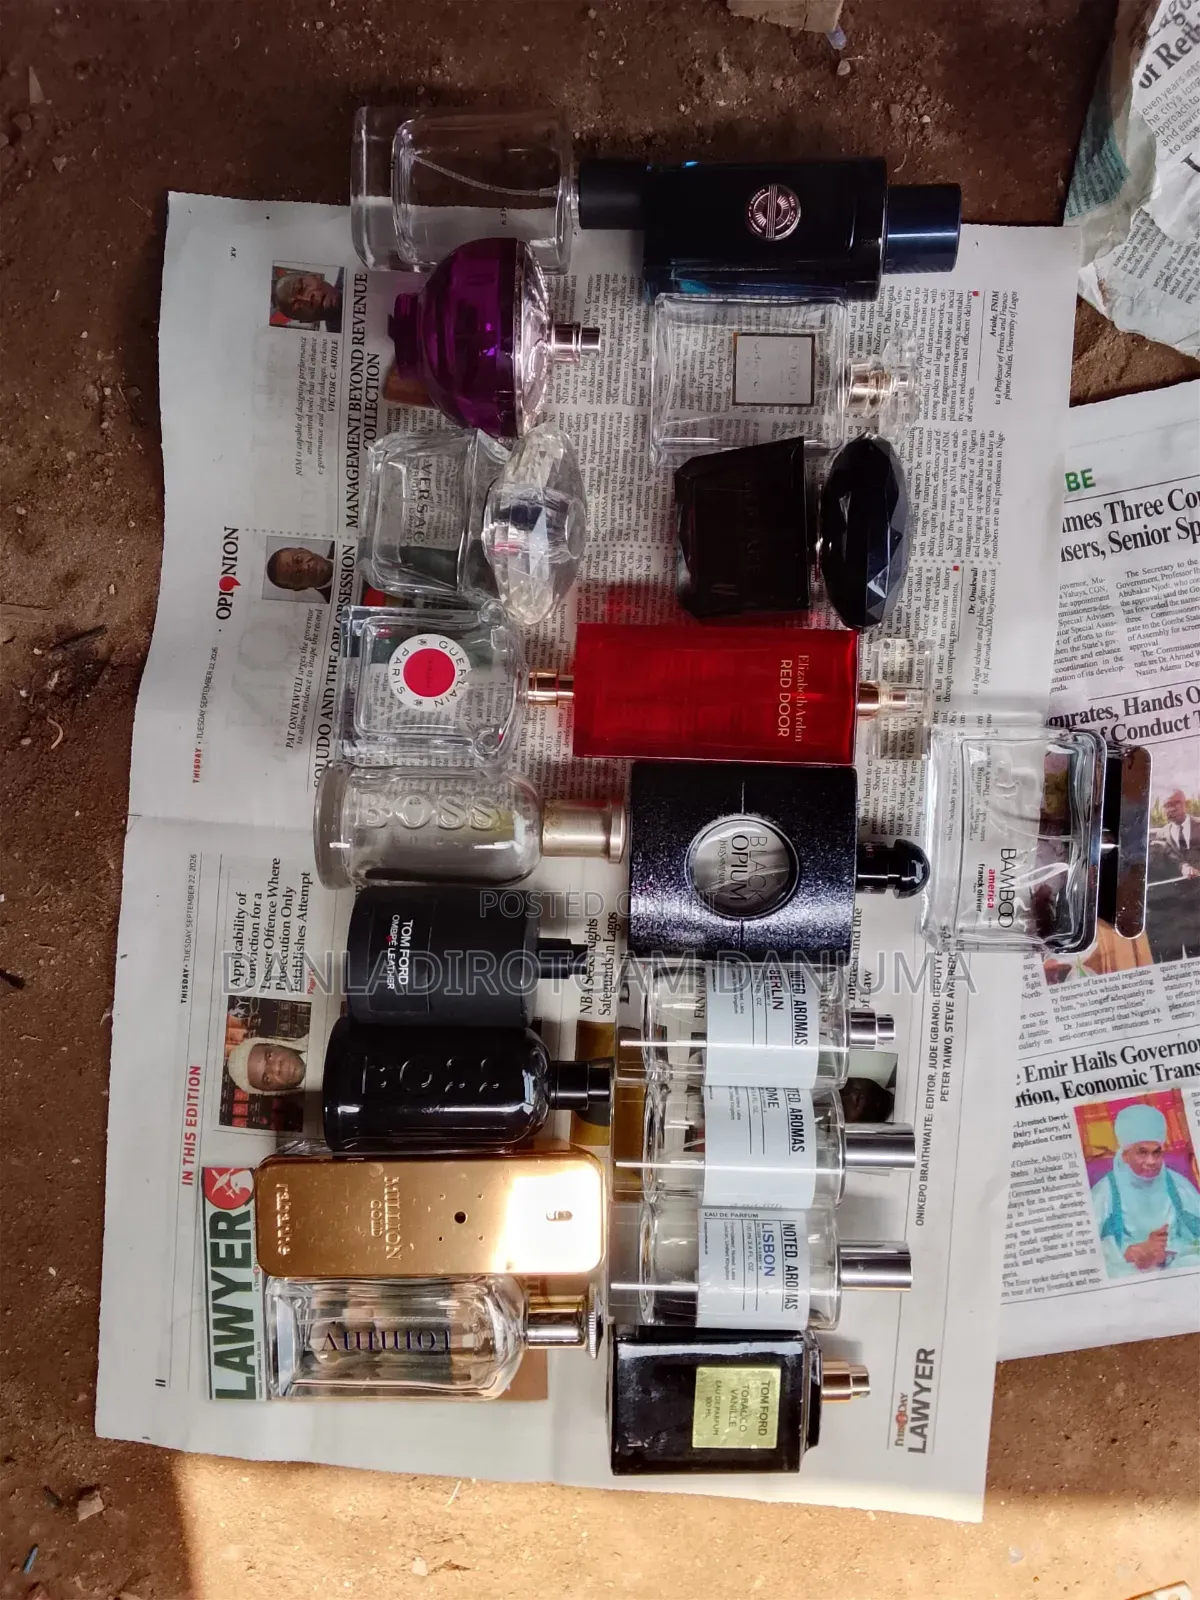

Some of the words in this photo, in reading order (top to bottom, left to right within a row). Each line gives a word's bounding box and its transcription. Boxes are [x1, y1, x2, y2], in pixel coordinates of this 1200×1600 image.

[1153, 102, 1192, 138] approach
[1160, 129, 1179, 147] and
[1168, 143, 1181, 155] to
[352, 273, 368, 346] REVENUE
[965, 290, 973, 317] delivery
[991, 290, 999, 312] FNIM
[1009, 291, 1019, 310] Lagos
[962, 319, 971, 345] efficient
[989, 314, 998, 337] Ariole,
[994, 364, 1004, 392] Professor
[1000, 292, 1008, 316] Franco-
[1007, 319, 1017, 352] University
[298, 336, 308, 380] performance
[309, 337, 318, 366] enhance
[320, 338, 328, 364] reckons
[330, 340, 339, 370] ARIOLE
[1004, 354, 1014, 378] Studies,
[329, 372, 337, 380] C.
[348, 349, 364, 412] BEYOND
[1003, 380, 1012, 400] phone
[296, 381, 307, 412] designing
[327, 382, 337, 412] VICTOR
[364, 352, 380, 450] COLLECTION
[296, 423, 305, 449] capable
[306, 415, 314, 439] control
[346, 414, 362, 528] MANAGEMENT
[414, 463, 433, 543] VERSAC
[1104, 499, 1164, 525] Three
[1167, 487, 1200, 512] Co
[991, 529, 999, 559] members
[1108, 524, 1171, 554] Senior
[968, 567, 978, 602] Onukwuli
[1142, 563, 1174, 575] Secretary
[1161, 569, 1192, 580] Professor
[312, 608, 323, 631] record
[967, 603, 976, 615] Dr.
[974, 642, 982, 666] scholar
[978, 585, 989, 605] affairs
[1086, 612, 1115, 622] Advisers
[288, 677, 304, 730] ONUKWULI
[301, 608, 314, 641] governor
[306, 646, 319, 672] shape
[392, 647, 410, 695] PARIS
[433, 640, 467, 708] GUERLAIN
[780, 660, 792, 688] RED
[1055, 661, 1098, 673] coordination
[199, 670, 213, 708] SEPTEMBER
[796, 655, 810, 706] Elizabeth
[300, 684, 311, 712] evidence
[320, 687, 336, 720] AND
[1122, 691, 1183, 717] Hands
[196, 709, 205, 739] TUESDAY
[777, 693, 791, 737] DOOR
[795, 708, 807, 742] Arden
[1110, 715, 1191, 742] Conduct
[192, 748, 202, 784] THISDAY
[187, 874, 196, 884] 22
[188, 854, 197, 872] 2026
[267, 857, 281, 898] Where
[729, 835, 749, 900] OPIUM
[747, 836, 767, 901] BLACK
[977, 864, 985, 888] franck
[235, 891, 247, 905] of
[280, 886, 296, 918] Only
[295, 871, 313, 922] Attempt
[976, 889, 984, 912] olivier
[987, 869, 996, 909] america
[998, 848, 1017, 928] BAMBOO
[184, 885, 196, 928] SEPTEMBER
[249, 901, 262, 920] for
[852, 908, 863, 927] the
[262, 900, 278, 949] Offence
[399, 919, 414, 947] TOM
[603, 912, 621, 942] Lagos
[183, 929, 192, 962] TUESDAY
[229, 907, 247, 987] Applicability
[245, 923, 261, 989] Conviction
[275, 921, 293, 991] Prosecution
[291, 924, 307, 992] Establishes
[261, 952, 274, 990] Lesser
[386, 948, 396, 990] LEATHER
[398, 949, 410, 985] FORD
[861, 970, 873, 995] Law
[932, 959, 943, 998] DEPUTY
[180, 968, 190, 1004] THISDAY
[580, 988, 593, 1014] NBA
[598, 958, 616, 1016] Safeguards
[769, 970, 784, 1010] BERLIN
[793, 1000, 808, 1045] AROMAS
[929, 999, 941, 1044] IGBANOI:
[943, 1002, 955, 1033] STEVE
[927, 1045, 939, 1070] JUDE
[942, 1035, 954, 1070] TAIWO,
[1023, 1060, 1069, 1083] Emir
[1071, 1050, 1118, 1074] Hails
[185, 1065, 201, 1127] EDITION
[786, 1088, 801, 1105] TED.
[926, 1071, 938, 1110] EDITOR,
[940, 1072, 952, 1102] PETER
[1059, 1068, 1149, 1100] Economic
[789, 1108, 805, 1152] AROMAS
[182, 1131, 197, 1166] THIS
[919, 1113, 934, 1182] BRAITHWAITE:
[181, 1170, 194, 1186] IN
[384, 1177, 401, 1260] MILLION
[915, 1183, 927, 1227] ONIKEPO
[761, 1222, 776, 1277] LISBON
[783, 1223, 798, 1261] NOTED.
[784, 1265, 799, 1310] AROMAS
[208, 1210, 257, 1400] LAWYER
[728, 1389, 739, 1427] VANILLE
[739, 1384, 749, 1432] TOBACCO
[760, 1381, 770, 1404] TOM
[907, 1348, 936, 1454] LAWYER
[758, 1407, 769, 1436] FORD
